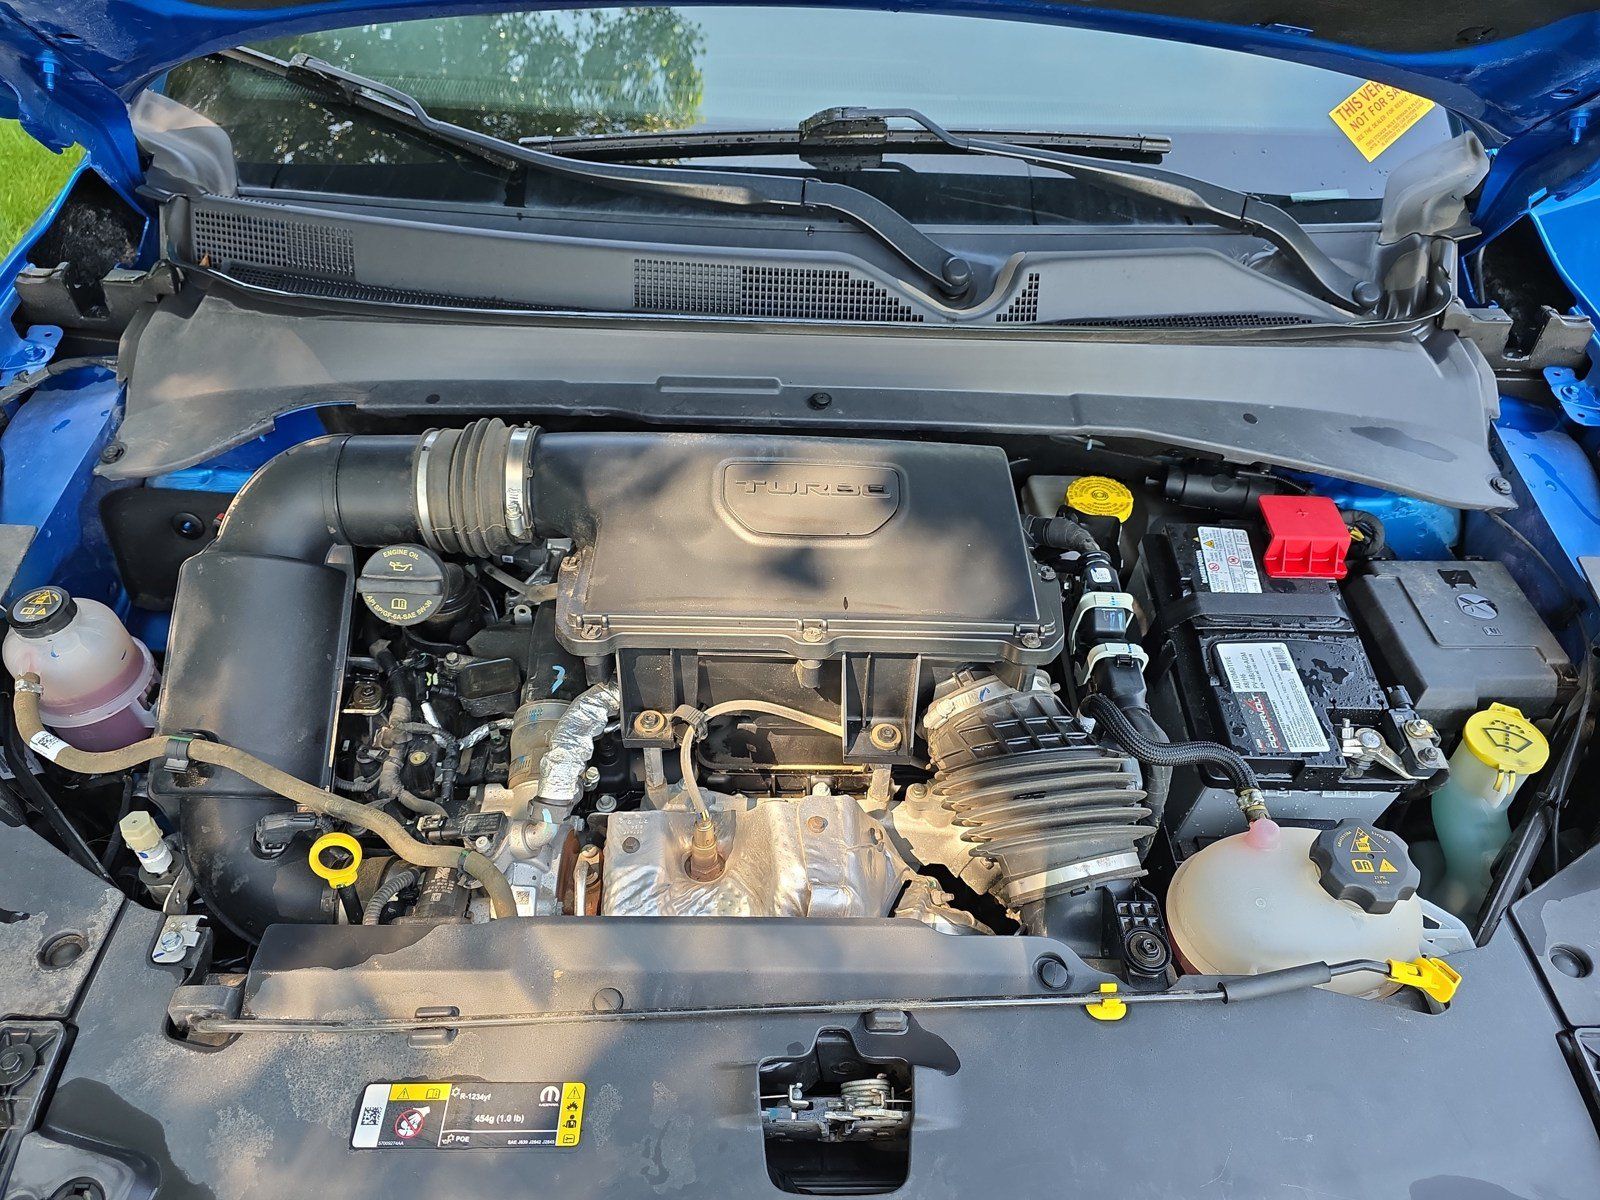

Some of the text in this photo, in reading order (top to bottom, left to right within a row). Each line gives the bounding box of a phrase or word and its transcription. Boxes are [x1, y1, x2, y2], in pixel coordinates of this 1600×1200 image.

[1335, 81, 1387, 121] THIS VEH
[1349, 111, 1370, 132] NOT
[1367, 97, 1388, 116] FOR
[1386, 87, 1402, 101] SA
[1371, 114, 1387, 129] DEALER
[735, 479, 892, 499] TURBO
[383, 549, 420, 561] ENGINE OIL
[1223, 656, 1242, 689] AUTOMOTIVE
[1251, 693, 1279, 749] POWERVOLT
[460, 1093, 491, 1102] R-1234yf
[474, 1114, 525, 1124] 454g (1.0 lb)
